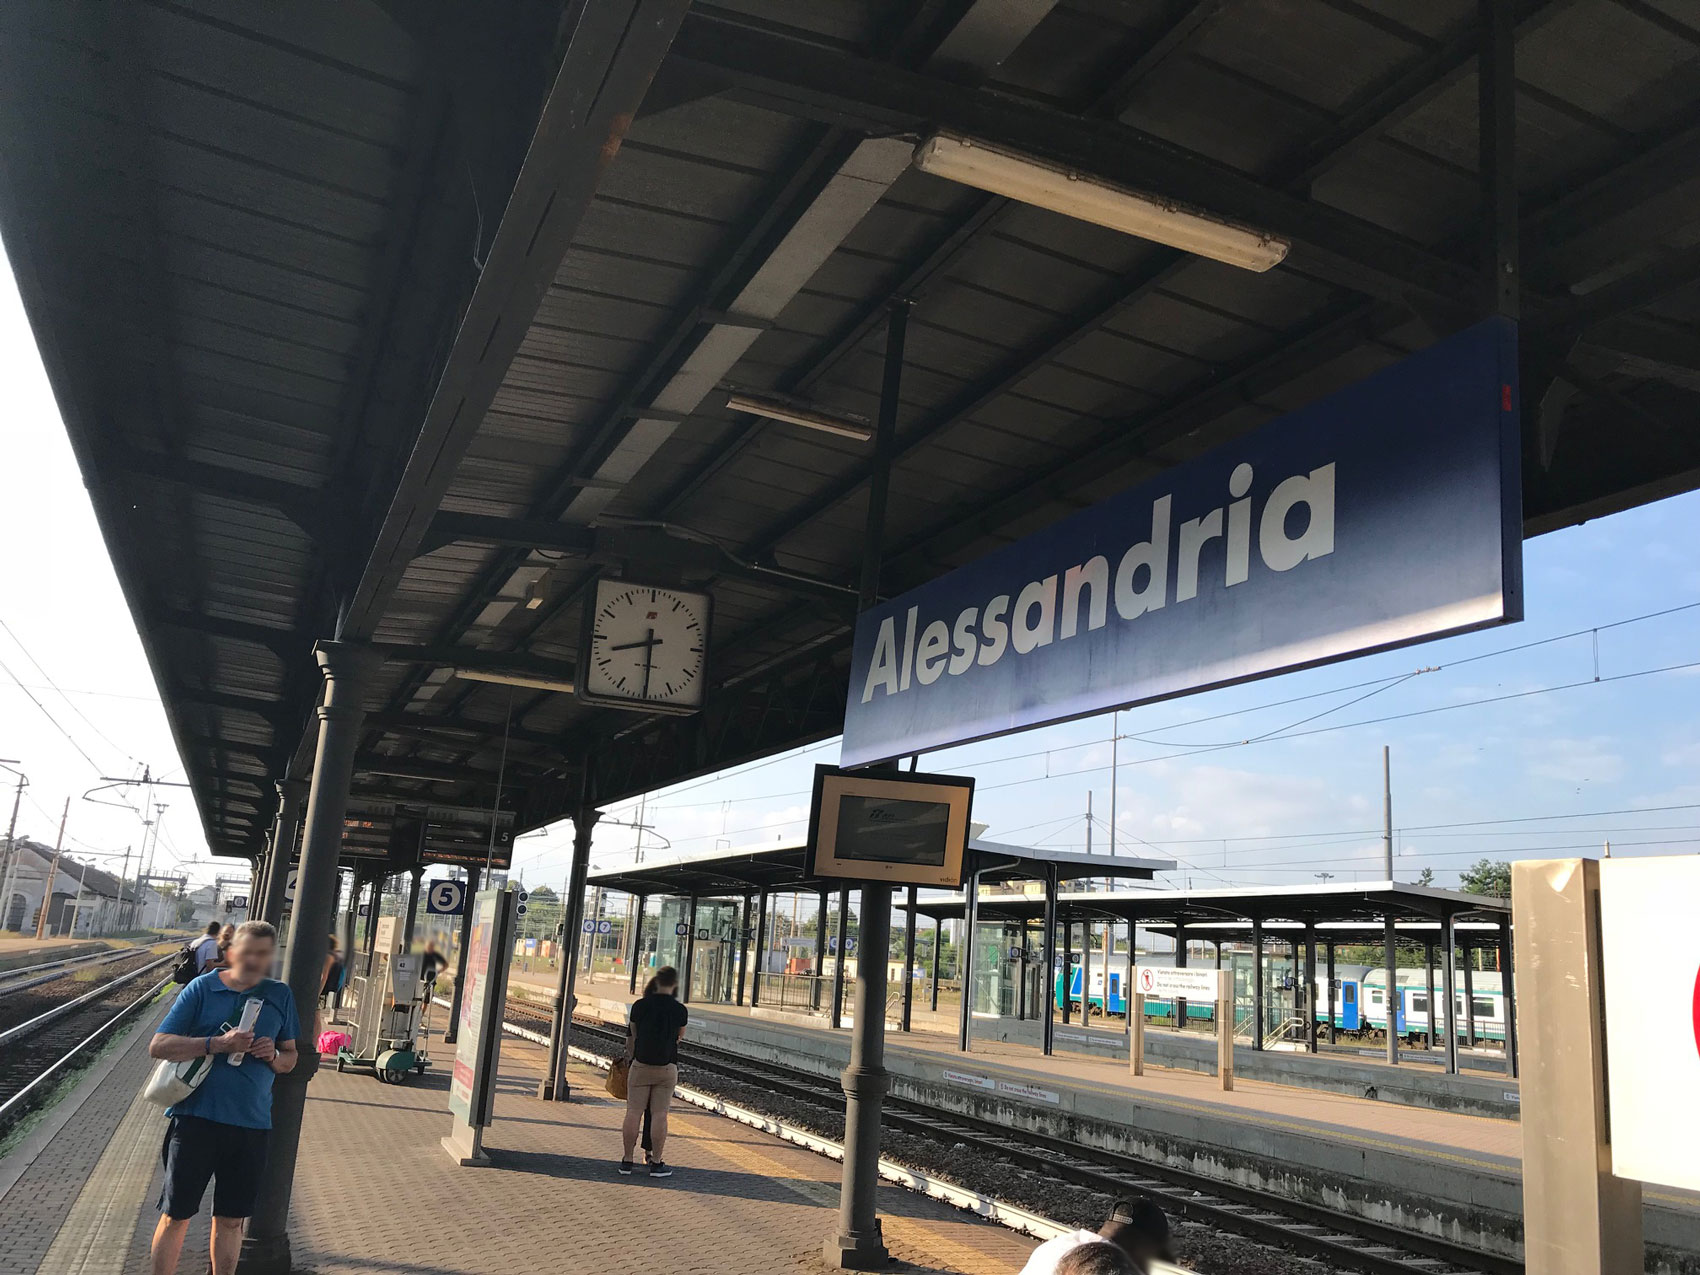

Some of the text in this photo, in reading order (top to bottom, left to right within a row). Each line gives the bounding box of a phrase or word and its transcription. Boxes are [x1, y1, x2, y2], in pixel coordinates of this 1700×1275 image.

[861, 461, 1335, 704] Alessandria
[501, 832, 509, 842] 5
[438, 887, 453, 907] 5
[602, 923, 609, 931] 7
